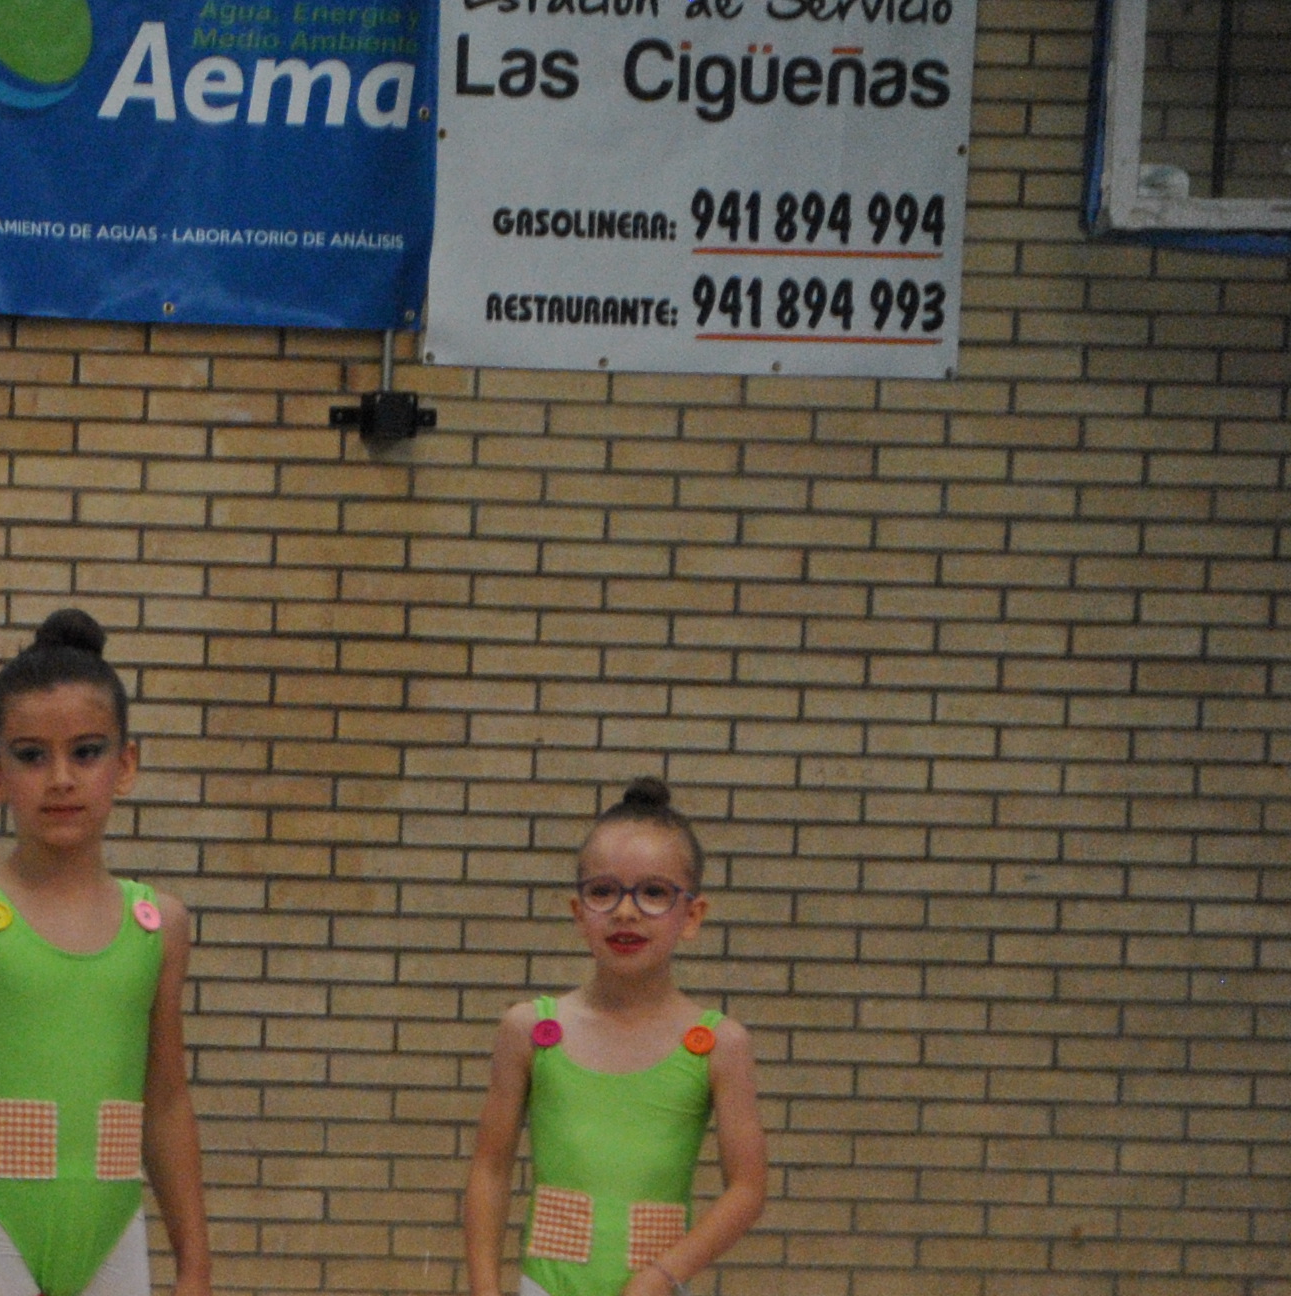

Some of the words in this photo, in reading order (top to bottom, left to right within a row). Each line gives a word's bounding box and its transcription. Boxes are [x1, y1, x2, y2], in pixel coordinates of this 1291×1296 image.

[97, 21, 416, 130] Aema
[456, 34, 580, 100] Las
[623, 38, 951, 122] Cigüeñas
[70, 223, 91, 239] DE
[97, 225, 158, 242] AGUAS
[172, 228, 298, 246] LABORATORIO
[303, 232, 325, 247] DE
[493, 207, 677, 241] GASOLINERA:
[691, 188, 760, 242] 941
[775, 192, 851, 244] 894
[868, 192, 945, 246] 994
[486, 293, 678, 327] RESTAURANTE:
[692, 274, 762, 328] 941
[776, 278, 854, 330] 894
[870, 280, 946, 332] 993
